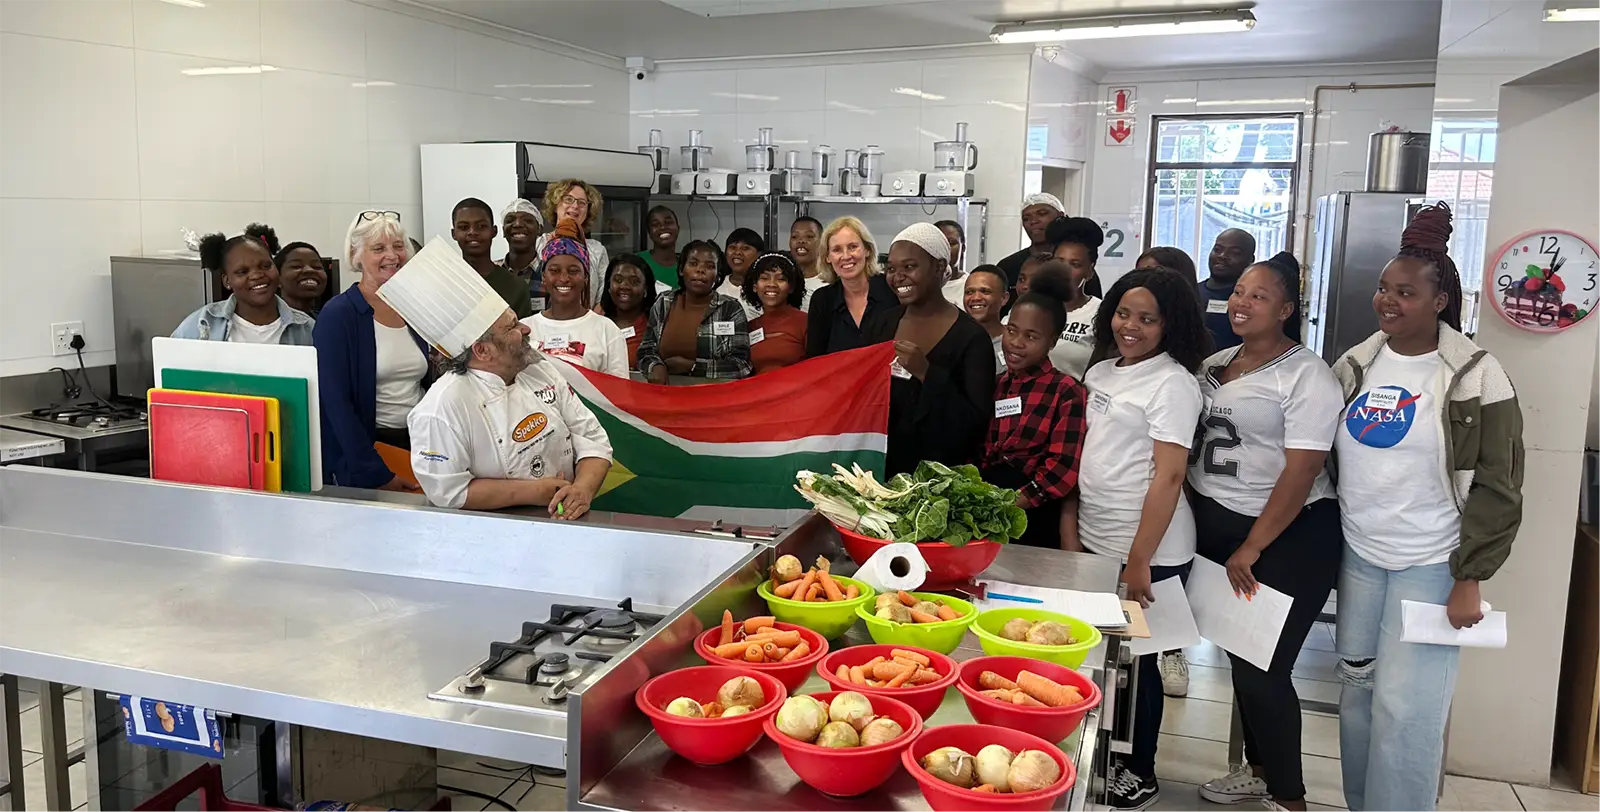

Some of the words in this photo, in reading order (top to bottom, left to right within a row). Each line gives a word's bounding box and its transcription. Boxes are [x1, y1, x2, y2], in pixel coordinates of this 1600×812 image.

[1540, 236, 1558, 254] 12
[1512, 248, 1519, 256] 11
[1501, 261, 1508, 270] 10
[1588, 261, 1595, 269] 2
[1497, 274, 1513, 292] 9
[1583, 273, 1597, 291] 3
[1583, 298, 1590, 306] 4
[1539, 306, 1559, 326] 6
[1371, 392, 1397, 401] SISANGA
[996, 403, 1020, 411] NKOSANA
[1353, 406, 1406, 422] NASA
[515, 416, 545, 440] Spekko
